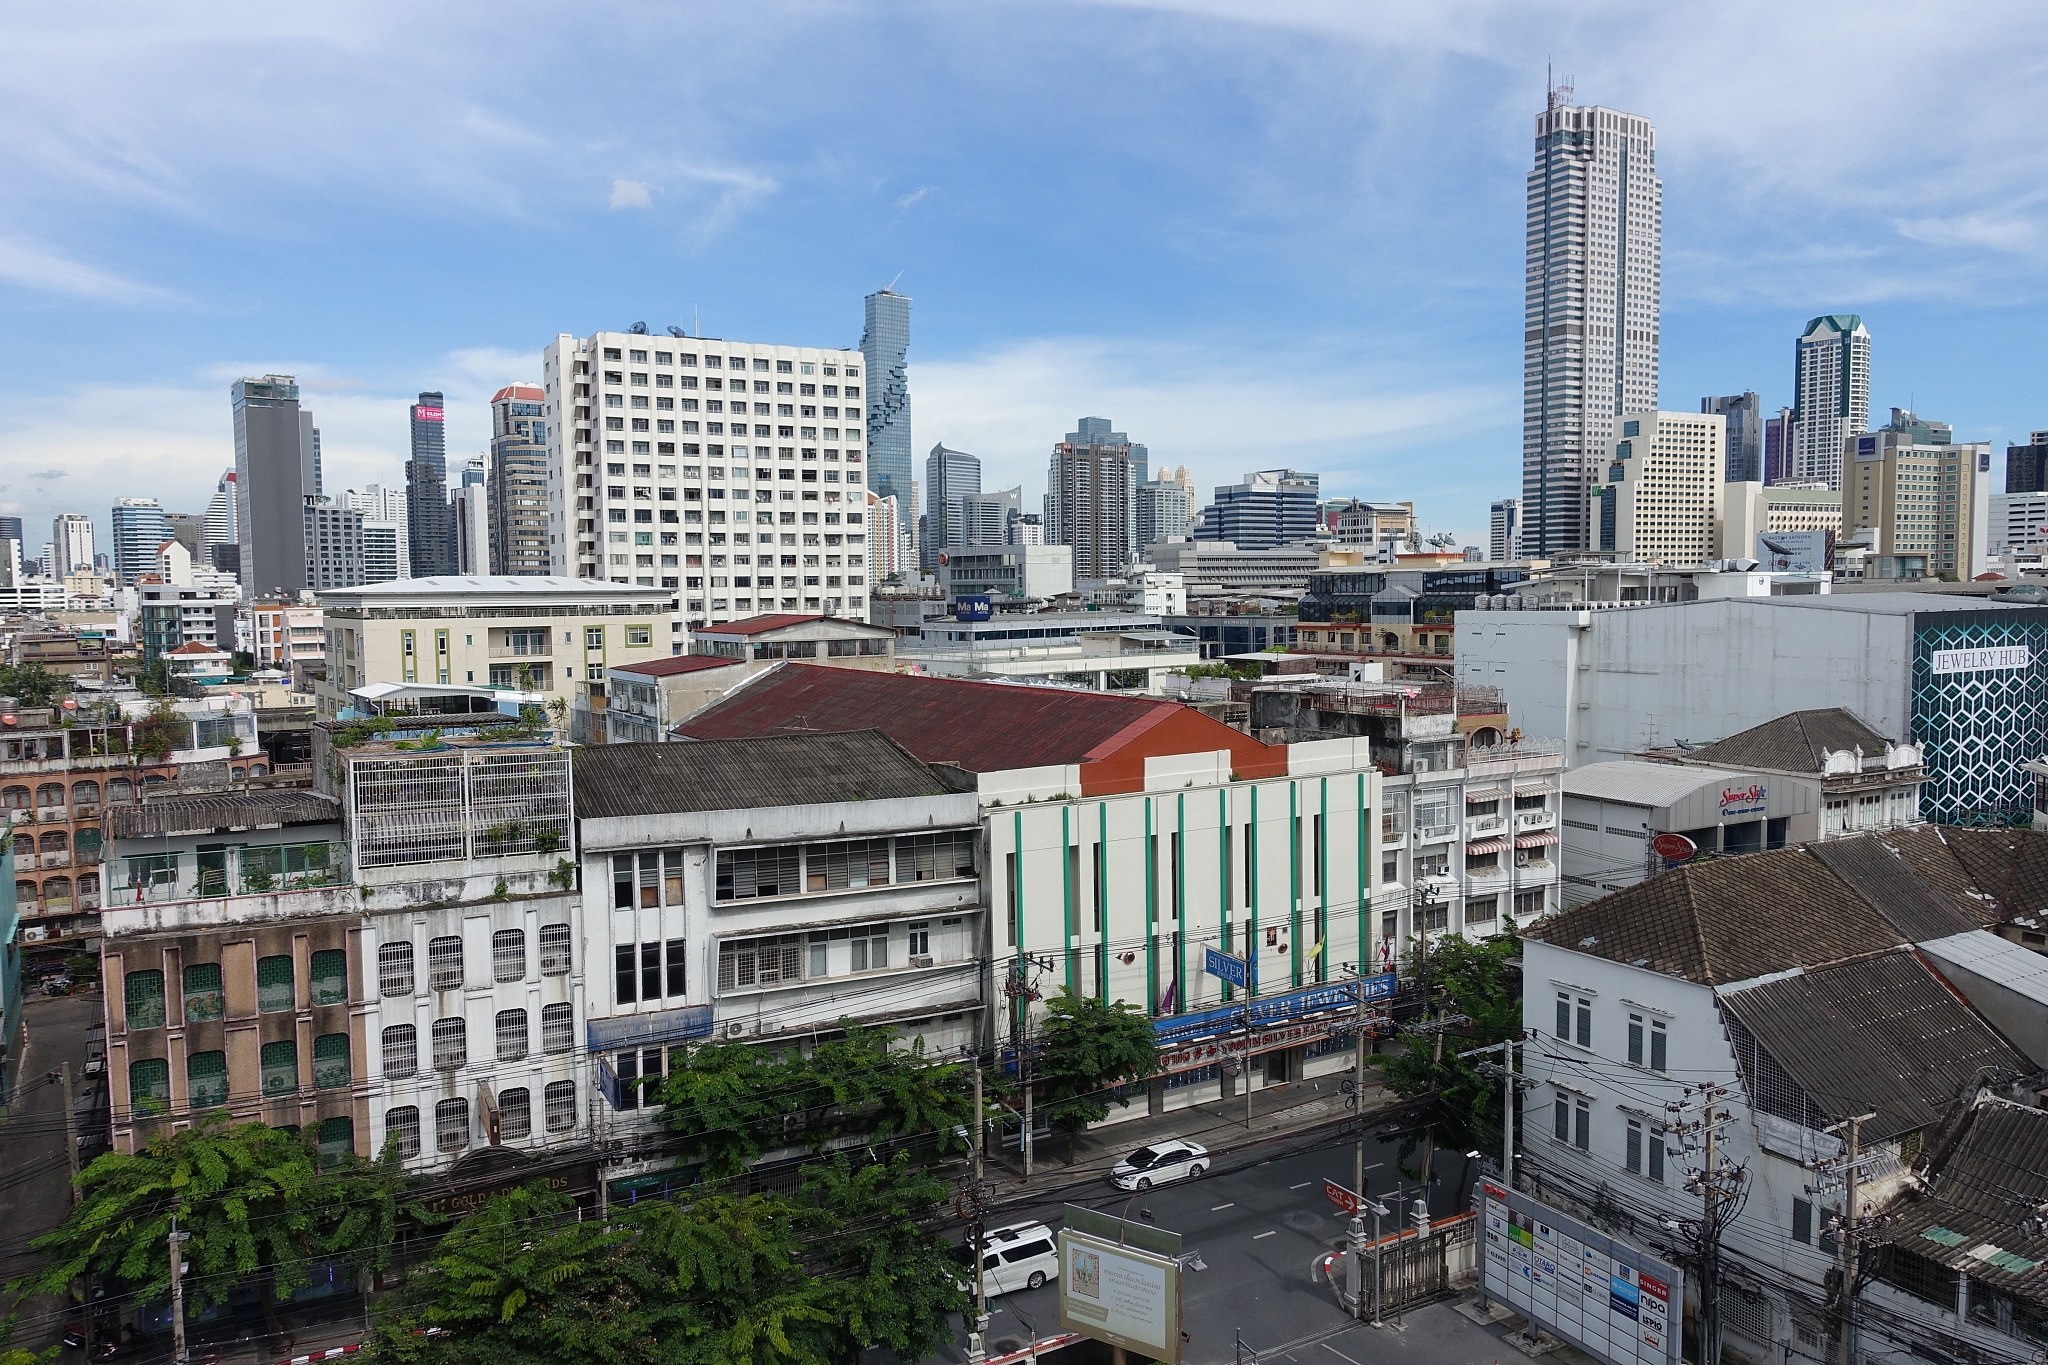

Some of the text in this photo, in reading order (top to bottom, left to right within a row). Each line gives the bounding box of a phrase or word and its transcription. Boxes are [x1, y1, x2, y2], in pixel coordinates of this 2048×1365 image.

[1010, 492, 1017, 500] W
[957, 602, 989, 611] Ma Ma
[1936, 649, 2026, 670] JEWELRY HUB
[1208, 956, 1243, 980] SILVER
[451, 1192, 486, 1209] GOLD
[1326, 1185, 1344, 1200] CAT
[1639, 1278, 1668, 1297] SINGER
[1640, 1294, 1665, 1314] nipa
